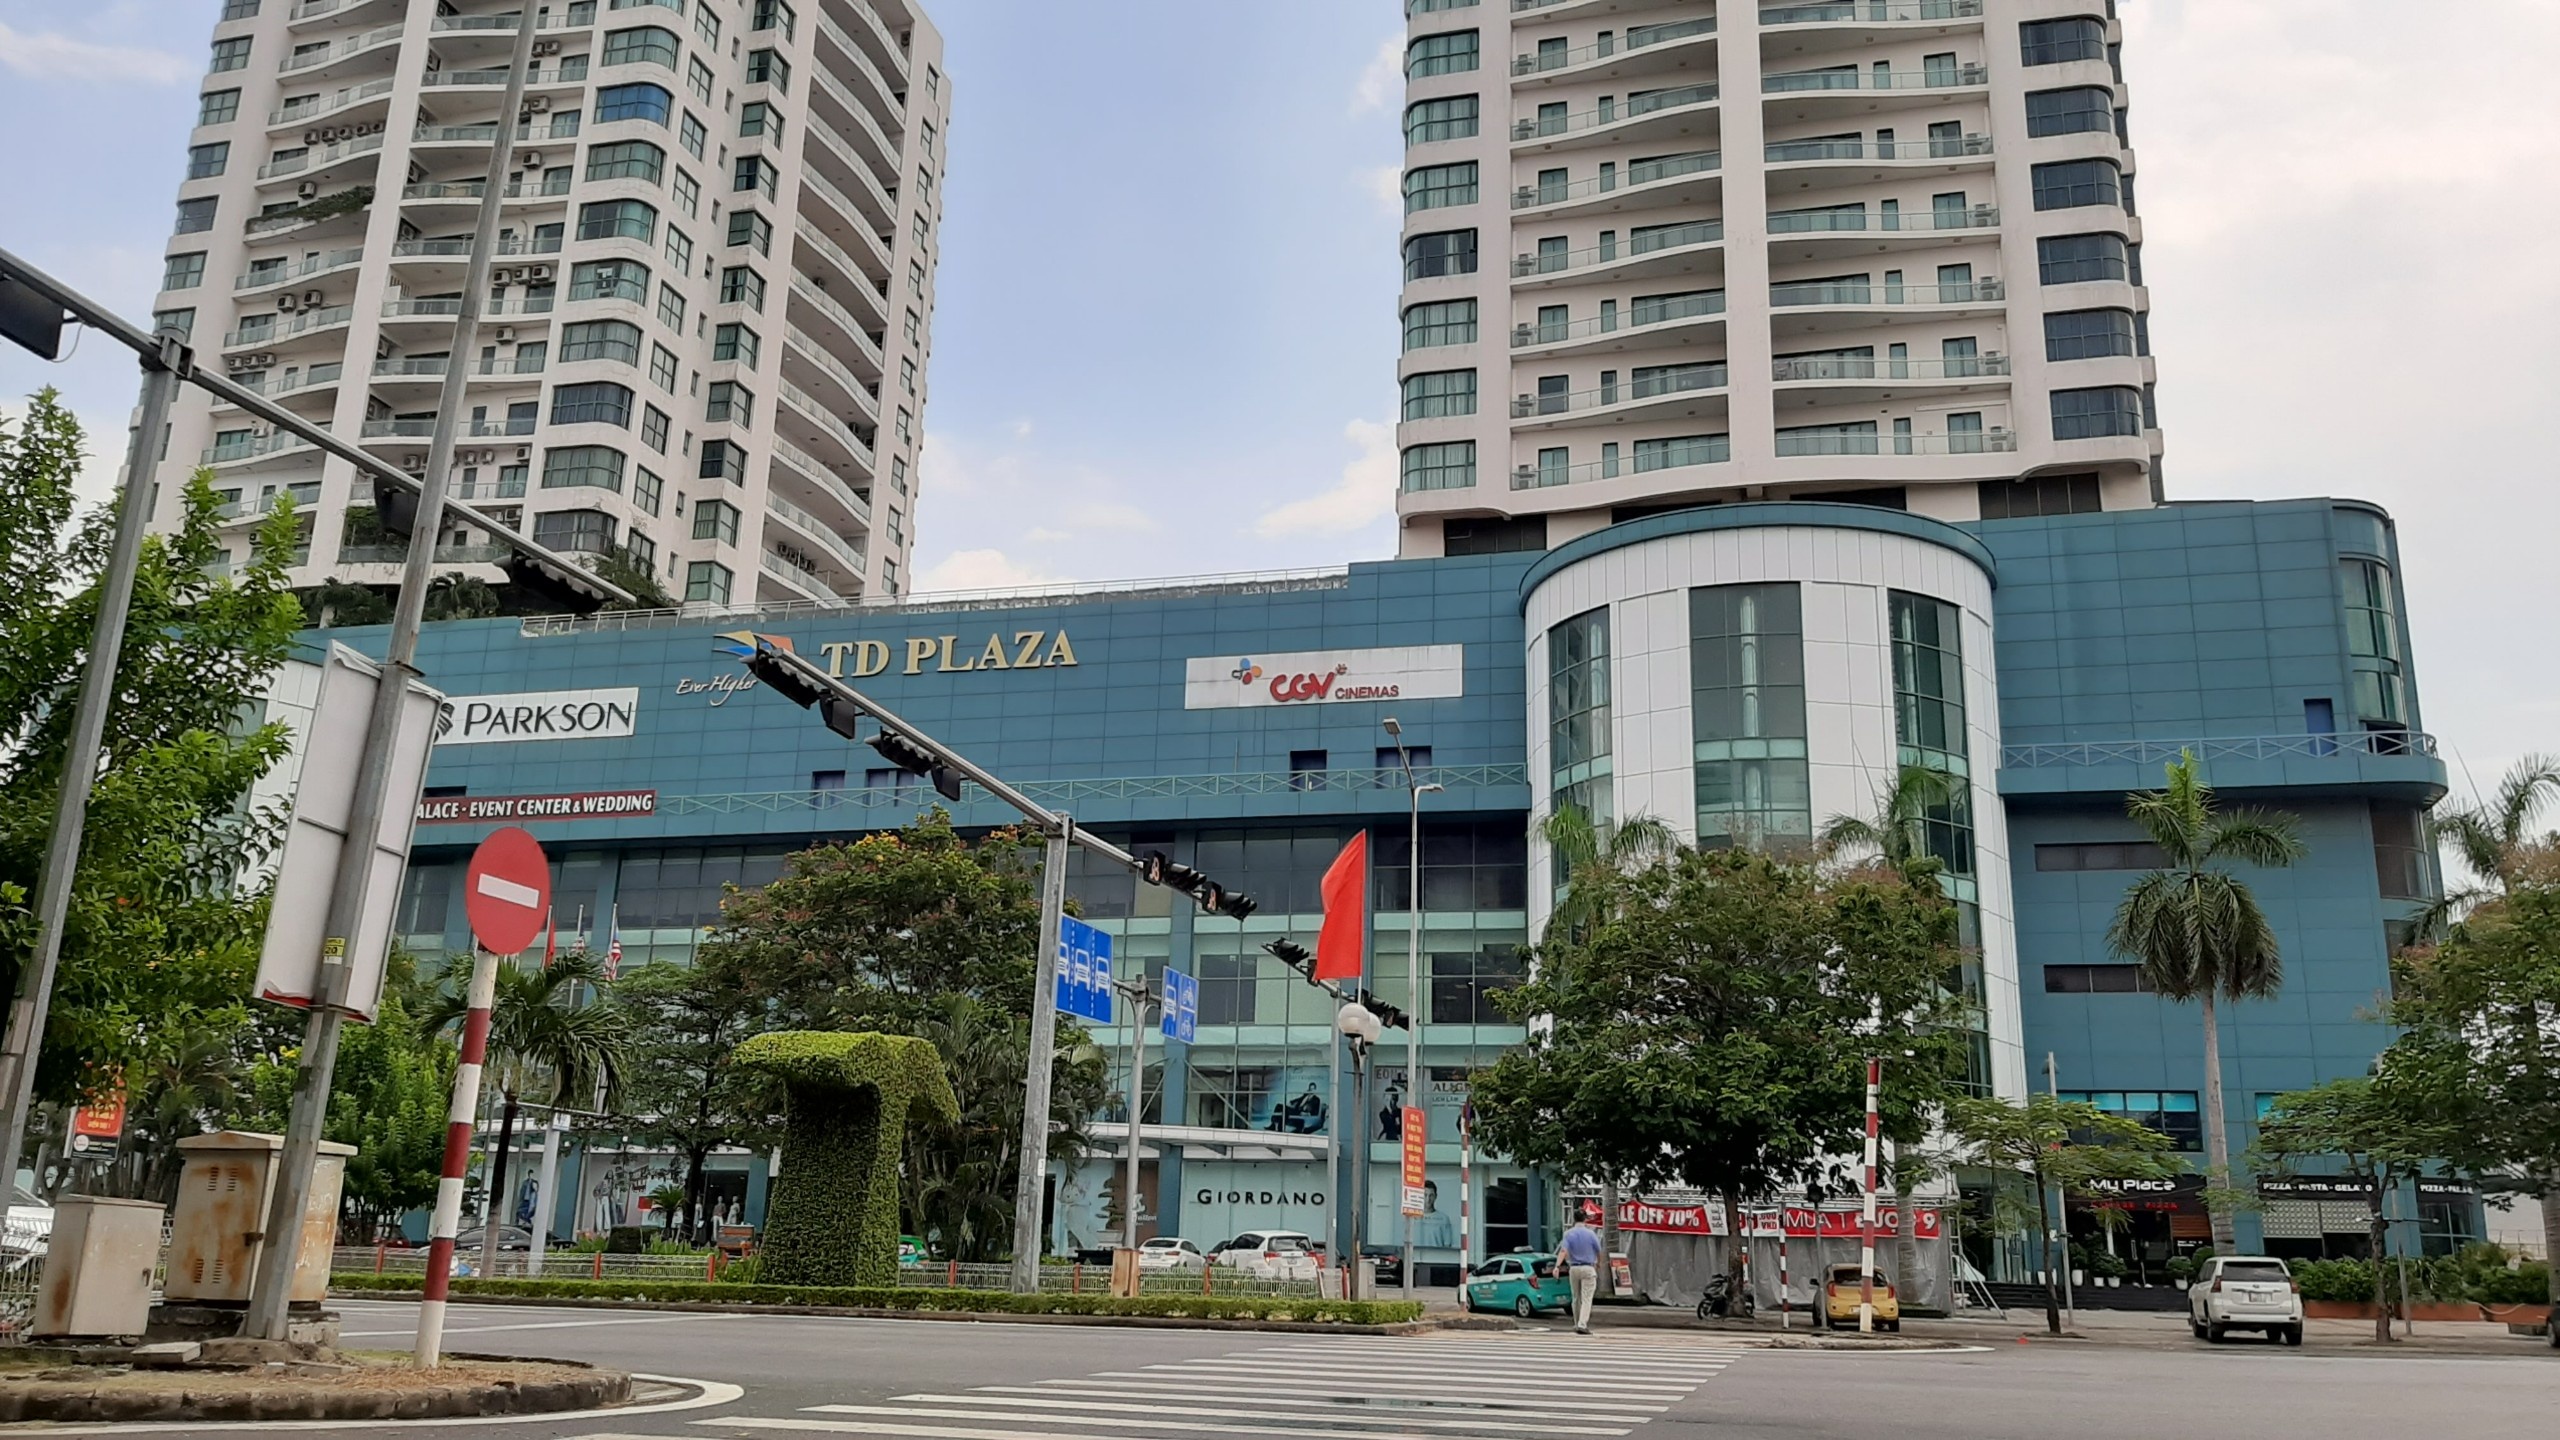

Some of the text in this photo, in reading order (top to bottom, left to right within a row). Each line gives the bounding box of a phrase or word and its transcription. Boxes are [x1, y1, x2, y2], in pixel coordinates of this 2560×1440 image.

[820, 629, 1079, 679] TD PLAZA
[676, 669, 758, 707] Ever Higher
[1269, 671, 1400, 703] CGV CINEMAS
[463, 700, 633, 736] PARKSON
[416, 794, 653, 820] ALACE EVENT CENTER & WEDDING
[1197, 1188, 1325, 1206] GIORDANO
[2089, 1179, 2177, 1192] My Place
[2263, 1182, 2292, 1191] PIZZA
[2334, 1184, 2373, 1192] GELAO
[1618, 1205, 1636, 1222] LE
[1637, 1207, 1666, 1225] OFF
[1667, 1209, 1700, 1227] 70%
[1786, 1210, 1832, 1229] MUA
[1855, 1209, 1917, 1233] ĐƯỢ
[1922, 1212, 1936, 1230] 9
